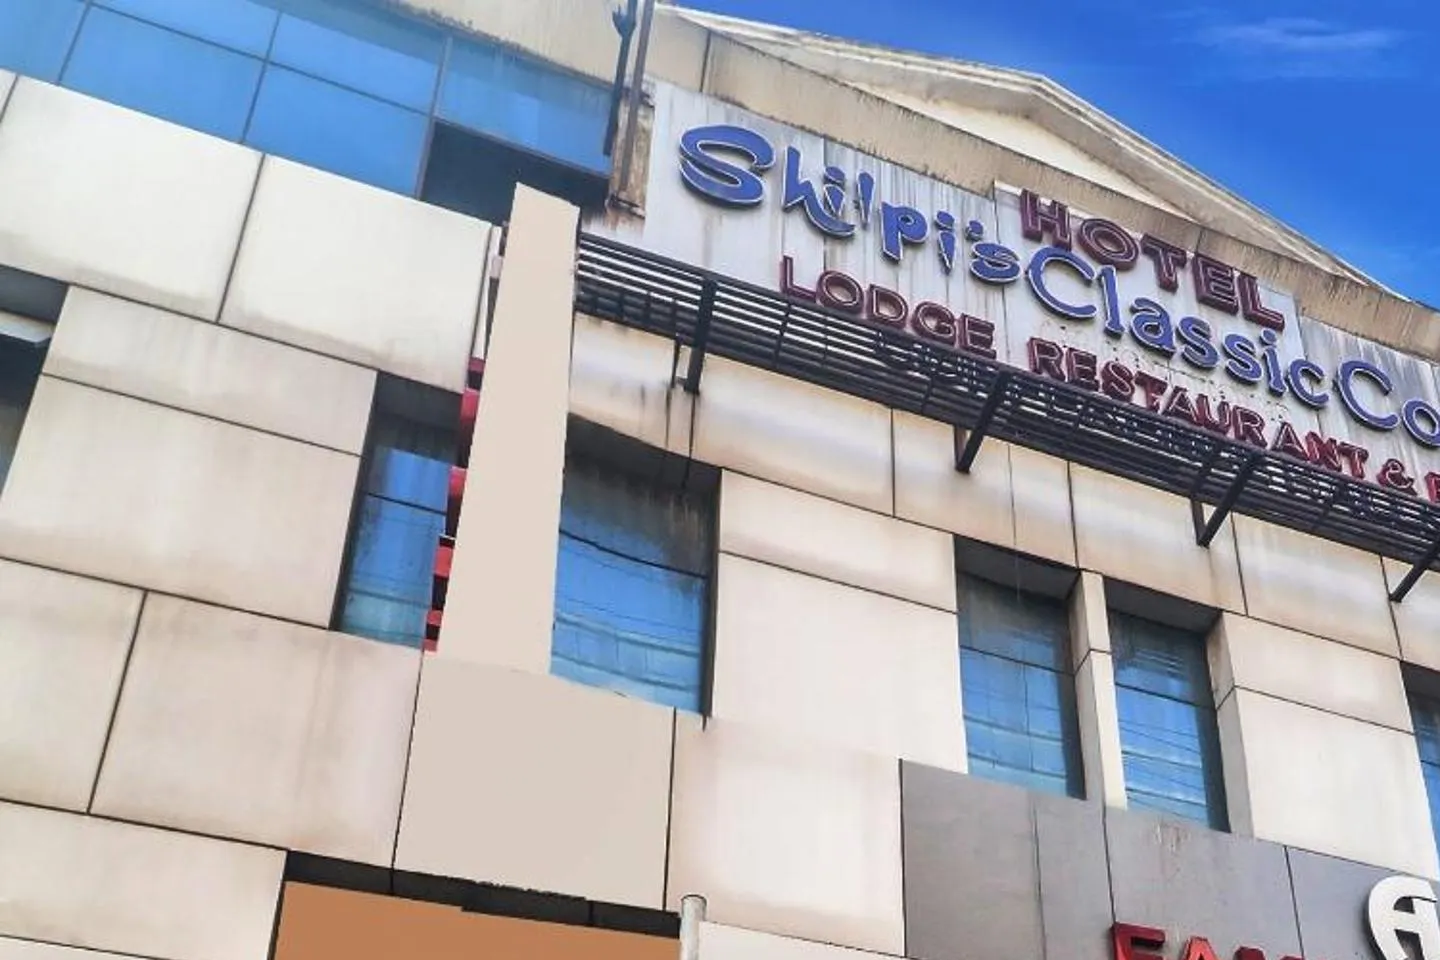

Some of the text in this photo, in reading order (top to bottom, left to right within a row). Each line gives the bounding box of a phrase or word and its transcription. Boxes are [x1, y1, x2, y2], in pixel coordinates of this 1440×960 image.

[1020, 187, 1285, 331] HOTEL
[780, 256, 997, 359] LODGE
[1027, 336, 1370, 478] RESTAURANT
[1376, 458, 1417, 495] &
